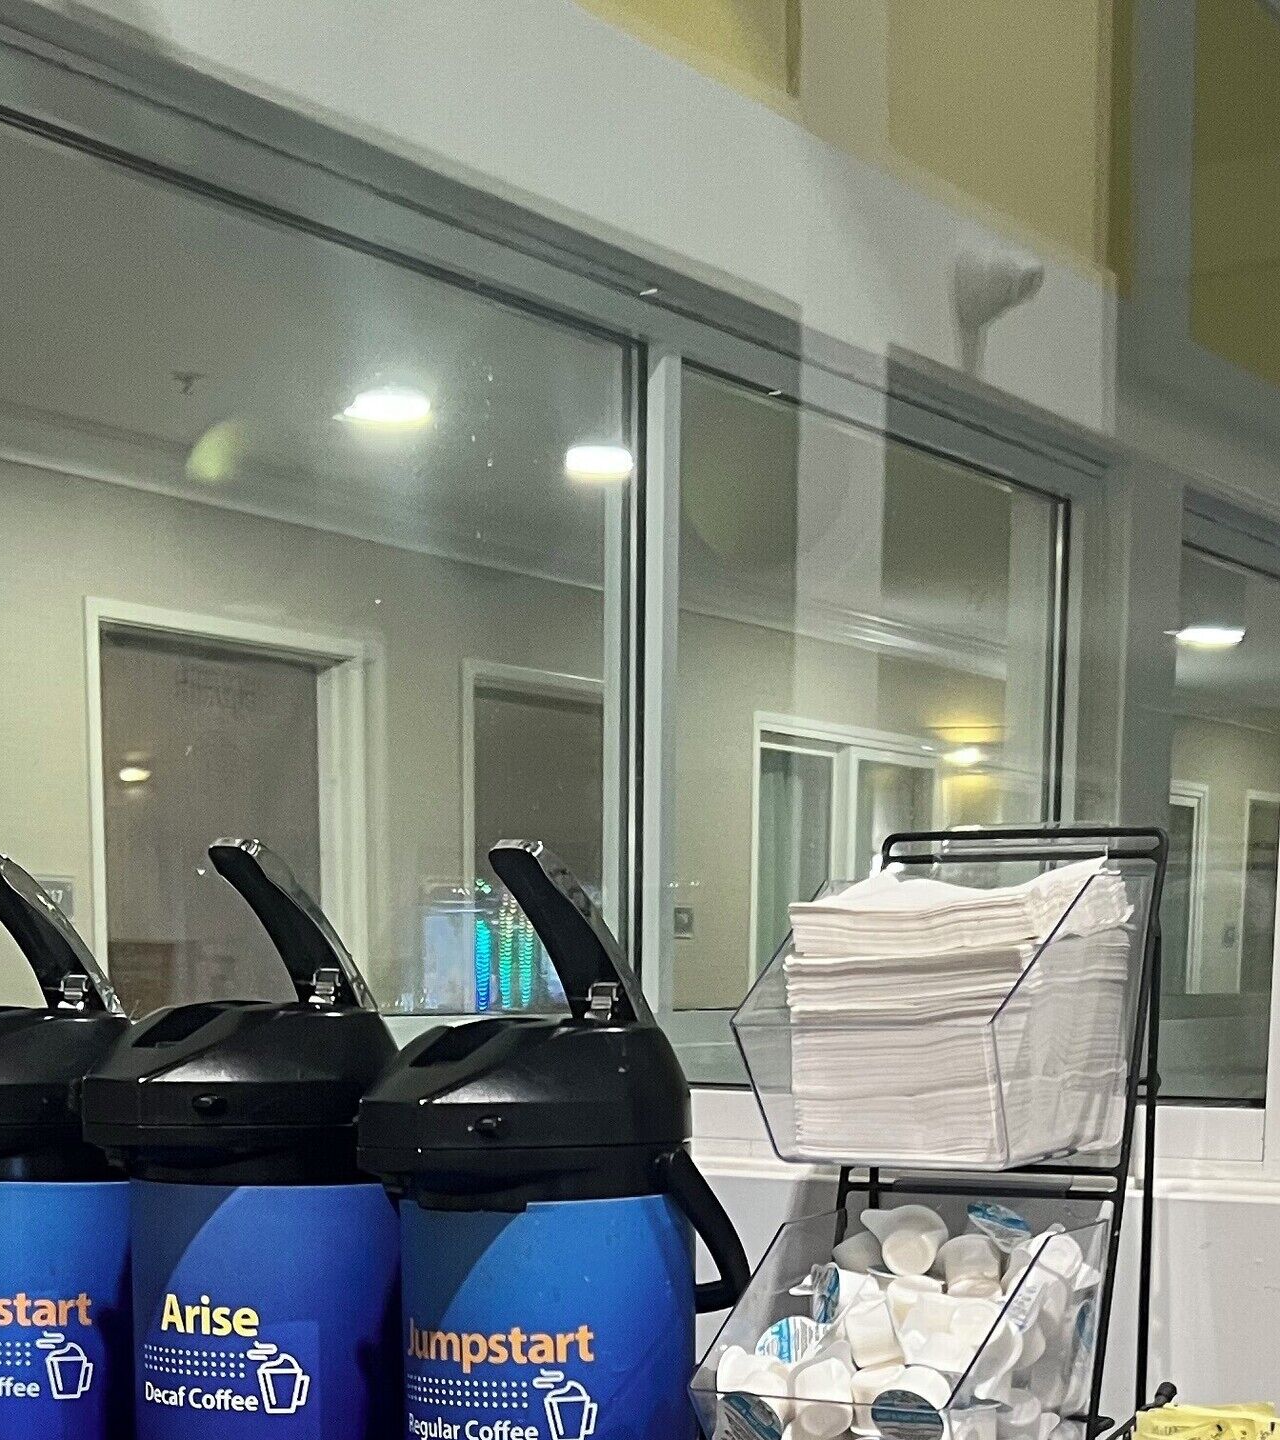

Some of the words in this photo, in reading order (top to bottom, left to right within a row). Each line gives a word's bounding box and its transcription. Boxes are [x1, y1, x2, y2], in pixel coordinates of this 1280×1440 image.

[161, 1293, 260, 1337] Arise
[408, 1317, 595, 1373] Jumpstart
[145, 1381, 186, 1407] Decaf
[188, 1388, 259, 1412] Coffee
[408, 1413, 460, 1440] Regular
